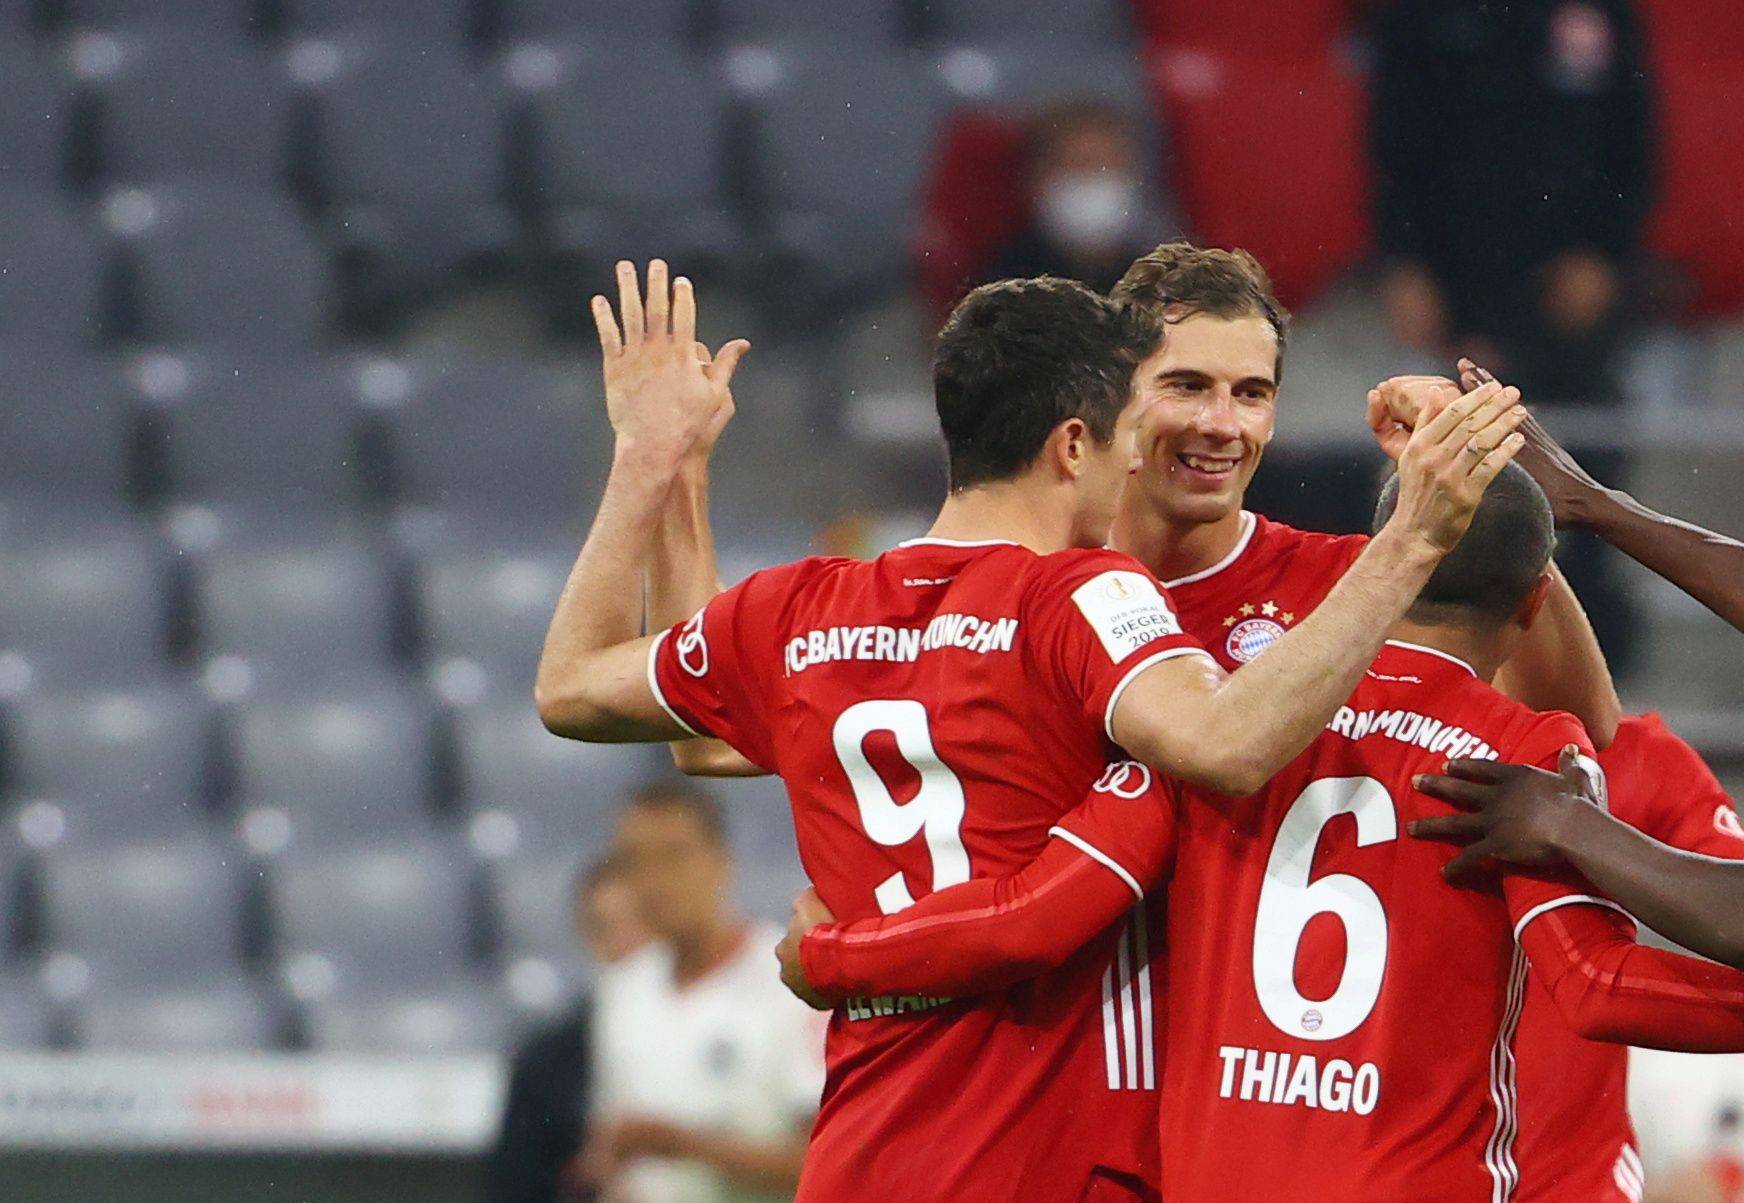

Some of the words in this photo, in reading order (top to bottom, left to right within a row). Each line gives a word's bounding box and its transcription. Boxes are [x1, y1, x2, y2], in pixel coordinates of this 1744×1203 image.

[805, 626, 921, 664] BAYERN
[1111, 614, 1170, 639] SIEGER
[832, 699, 972, 914] 9
[1252, 775, 1398, 1041] 6
[1218, 1046, 1381, 1116] THIAGO
